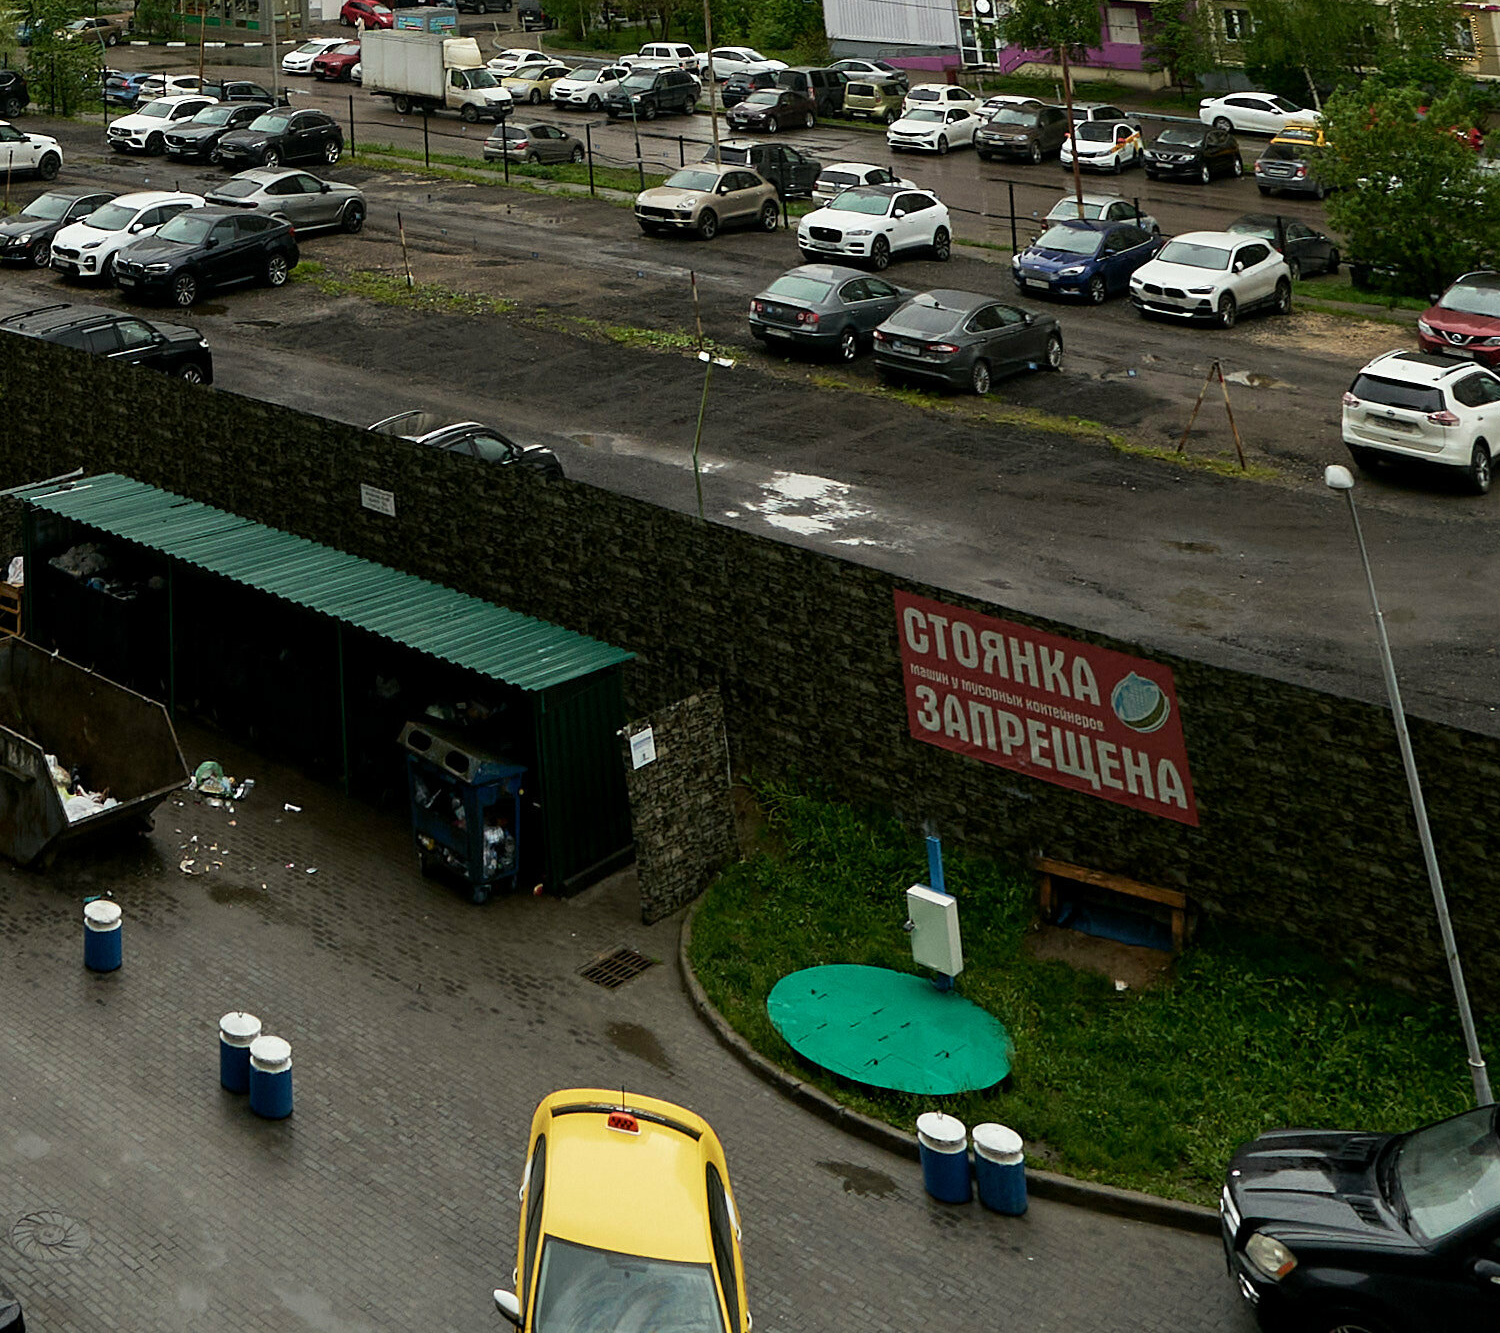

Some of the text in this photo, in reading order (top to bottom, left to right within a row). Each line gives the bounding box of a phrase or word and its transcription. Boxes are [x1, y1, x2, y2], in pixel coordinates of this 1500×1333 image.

[903, 607, 1101, 706] СТОЯНКА
[910, 663, 1104, 731] машин у мусорных контейнеров
[915, 685, 1188, 809] ЗАПРЕЩЕНА
